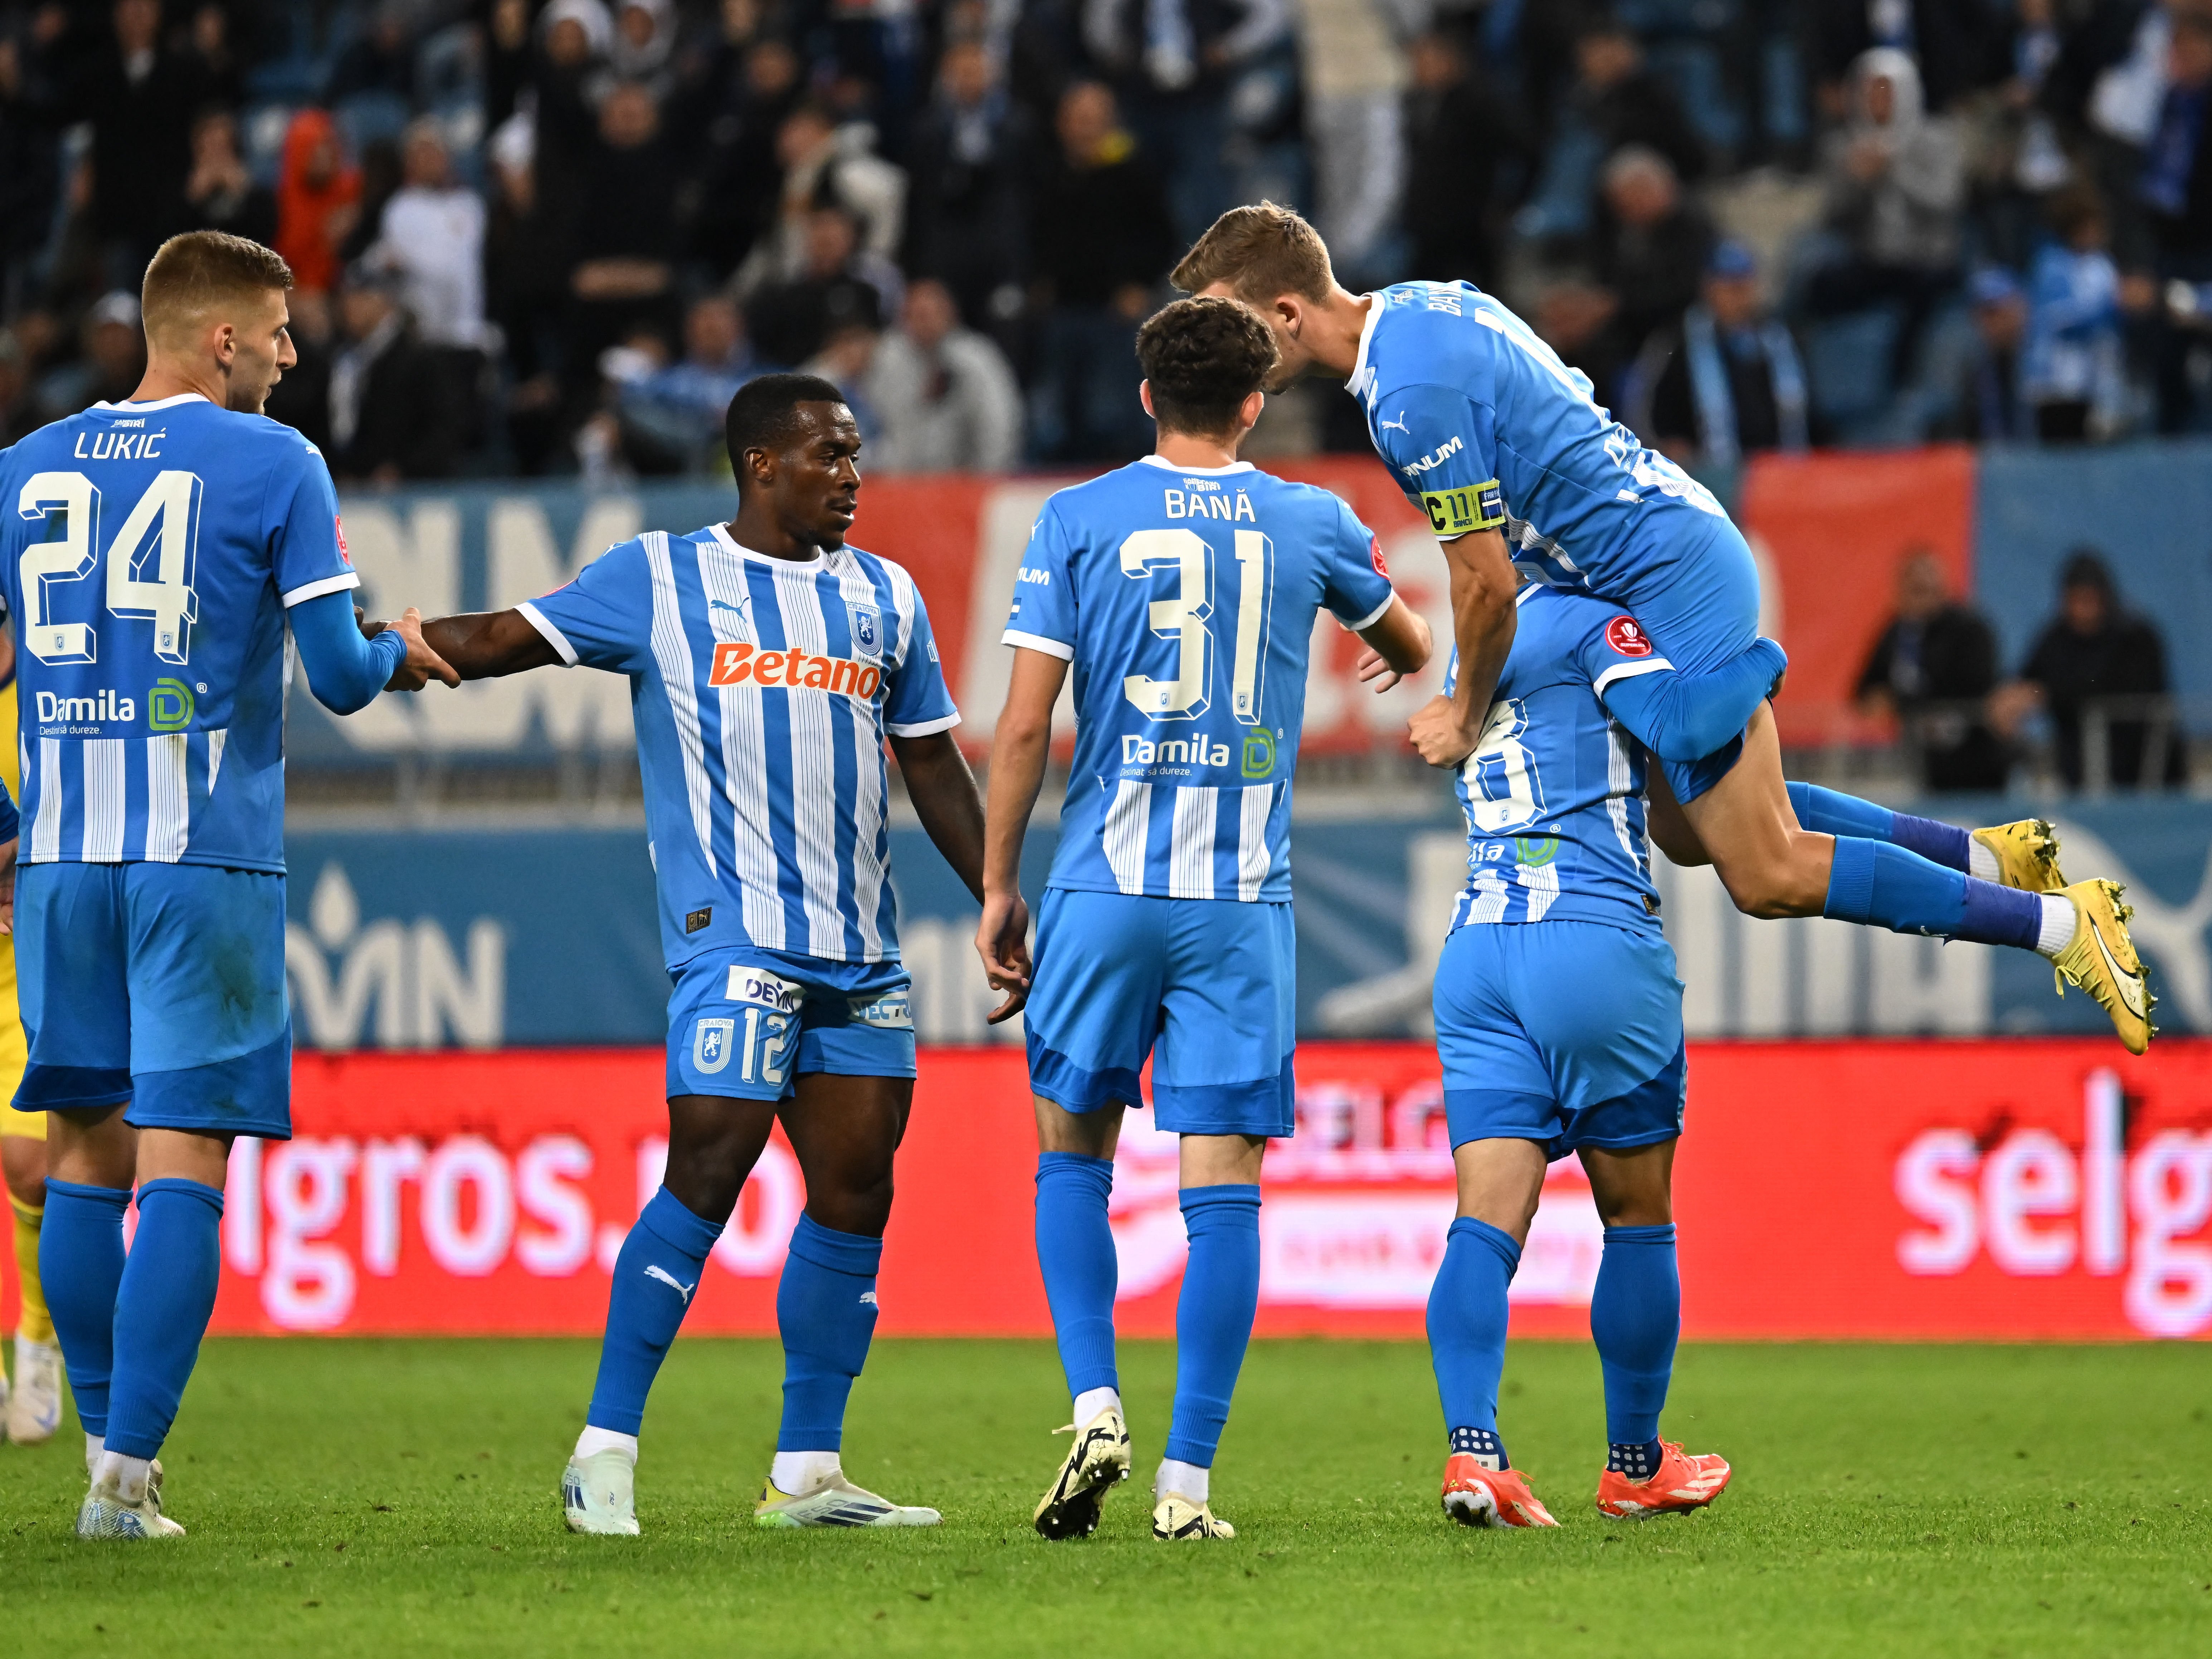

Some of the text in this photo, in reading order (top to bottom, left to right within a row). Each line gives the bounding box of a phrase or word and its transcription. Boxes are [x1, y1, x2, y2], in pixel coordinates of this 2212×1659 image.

[74, 428, 166, 459] LUKIĆ
[1164, 489, 1256, 523] BANĂ
[1426, 497, 1446, 530] C
[1446, 492, 1470, 519] 11
[1453, 518, 1473, 528] BANCU
[18, 470, 204, 665] 24
[847, 603, 877, 615] CRAIOVA
[1119, 528, 1273, 725] 31
[710, 643, 880, 700] Betano
[36, 689, 135, 722] Damila
[60, 725, 67, 734] să
[69, 725, 102, 734] dureze.
[1122, 732, 1230, 766] Damila
[1120, 766, 1192, 776] Destinat să dureze.
[745, 979, 794, 1013] DEVIN
[741, 1007, 788, 1086] 12
[1895, 1068, 2212, 1337] selg
